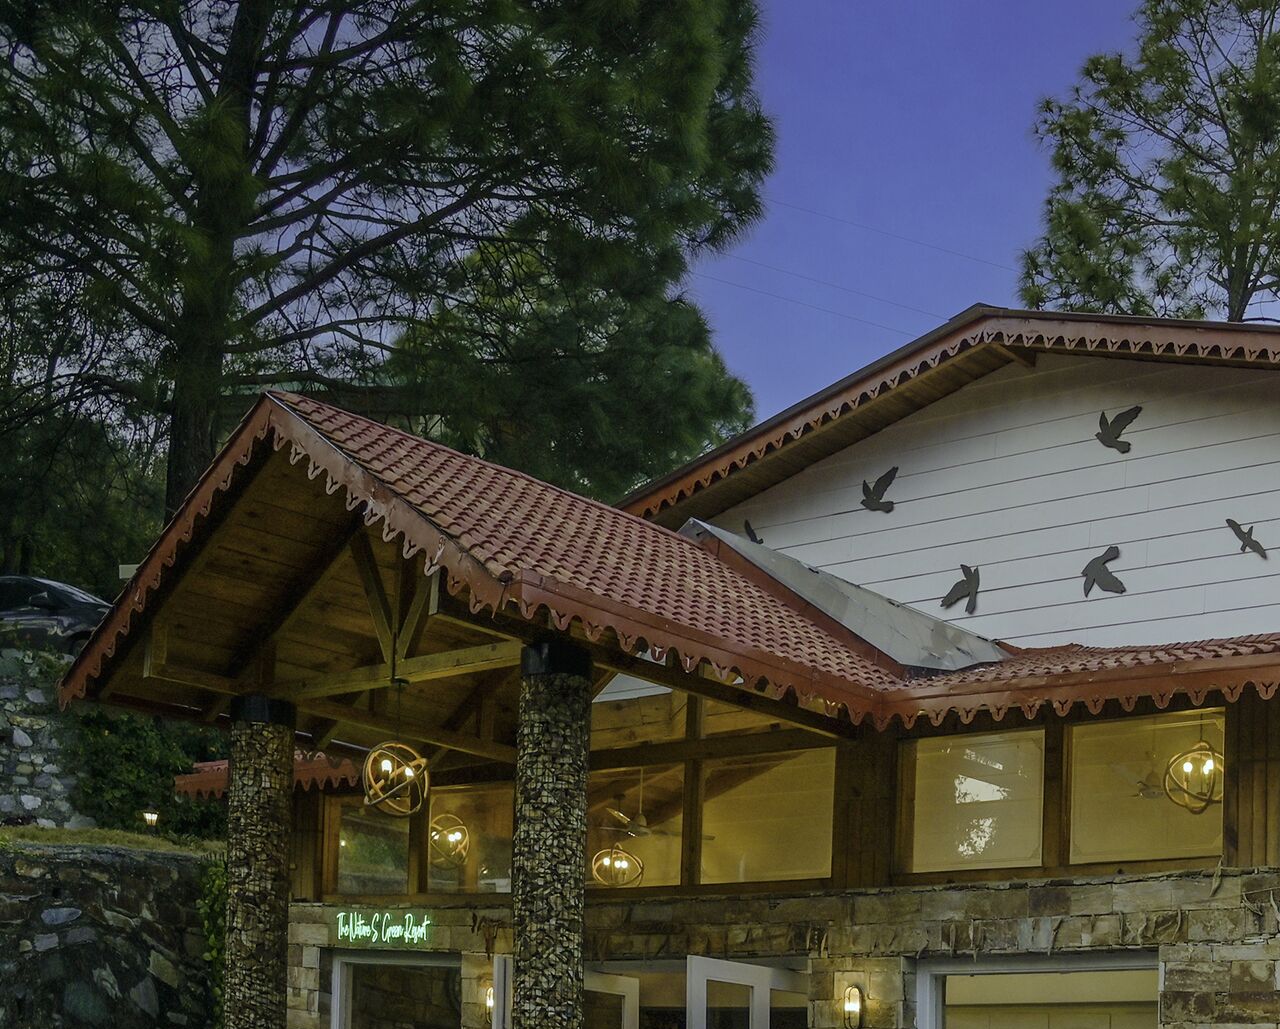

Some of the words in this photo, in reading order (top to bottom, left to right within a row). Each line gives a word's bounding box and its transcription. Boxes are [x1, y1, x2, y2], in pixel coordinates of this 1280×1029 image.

[336, 912, 349, 939] The
[381, 912, 404, 943] Green
[404, 913, 431, 943] Resort
